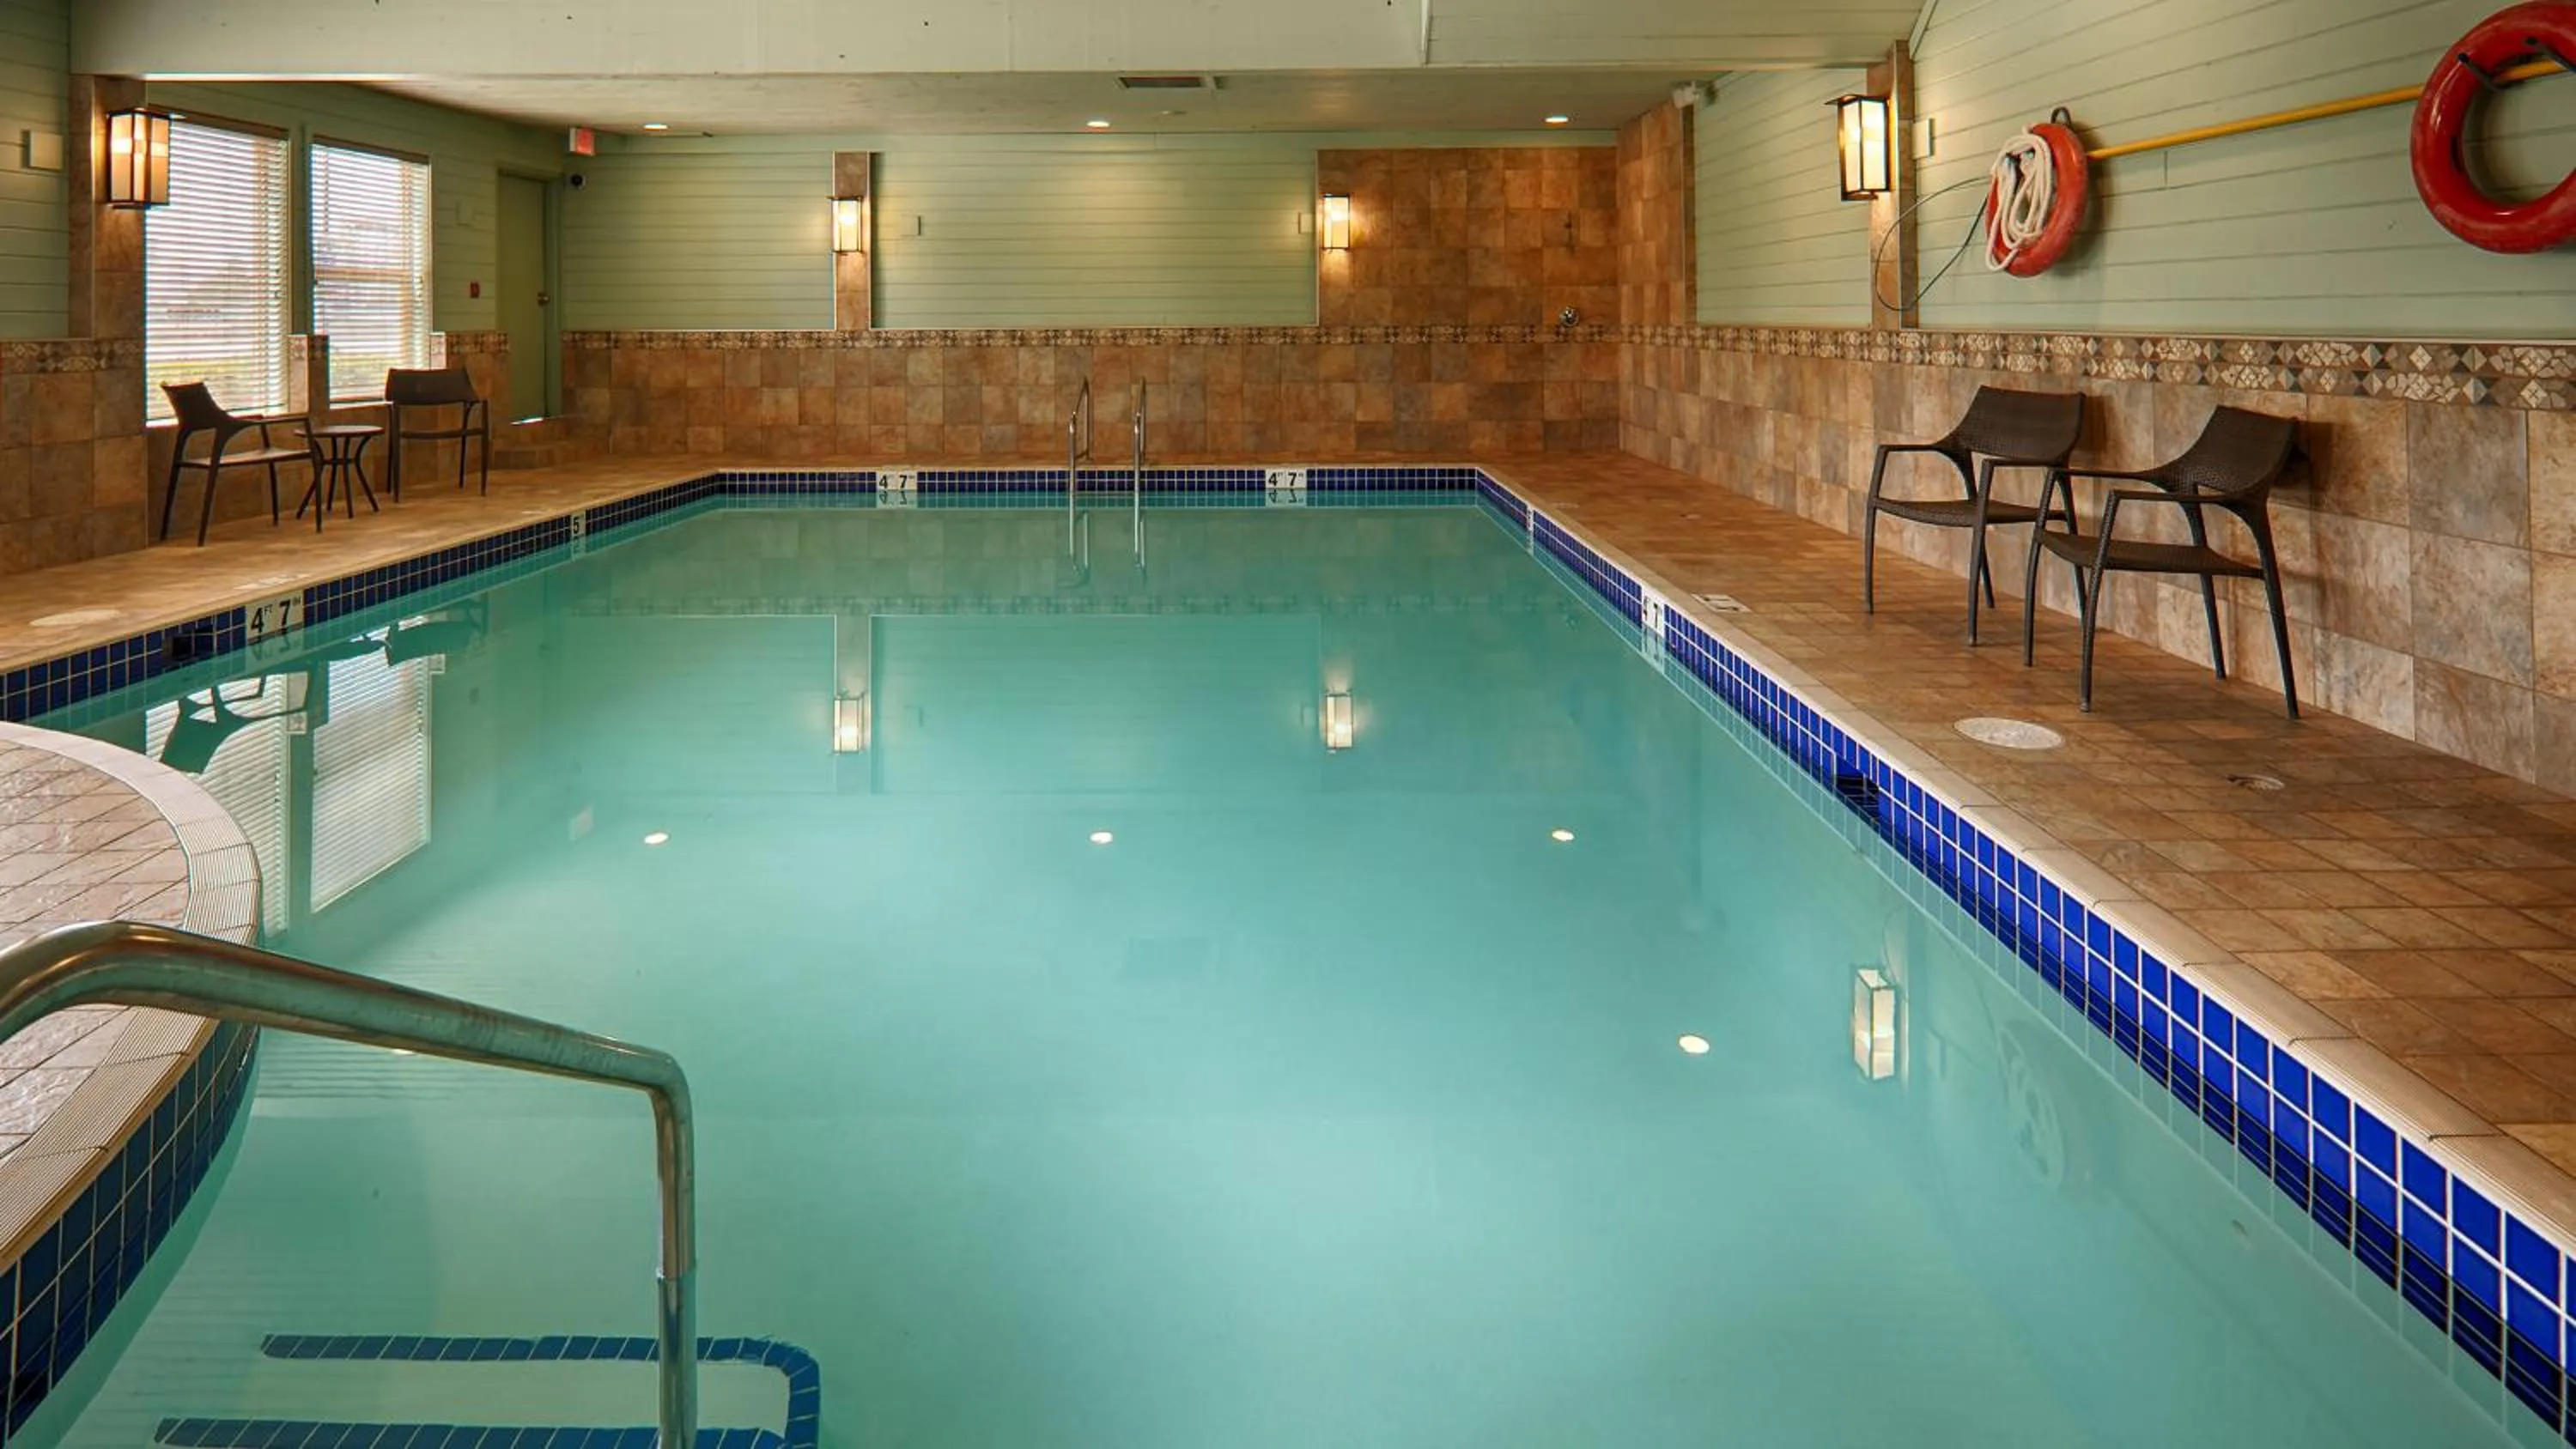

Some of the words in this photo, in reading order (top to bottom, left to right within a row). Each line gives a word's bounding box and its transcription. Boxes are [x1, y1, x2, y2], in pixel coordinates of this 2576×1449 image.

[879, 475, 888, 488] 4
[899, 475, 908, 488] 7
[1268, 472, 1278, 487] 4
[1288, 472, 1297, 487] 7
[574, 516, 580, 534] 5
[251, 608, 264, 633] 4
[279, 599, 290, 627] 7
